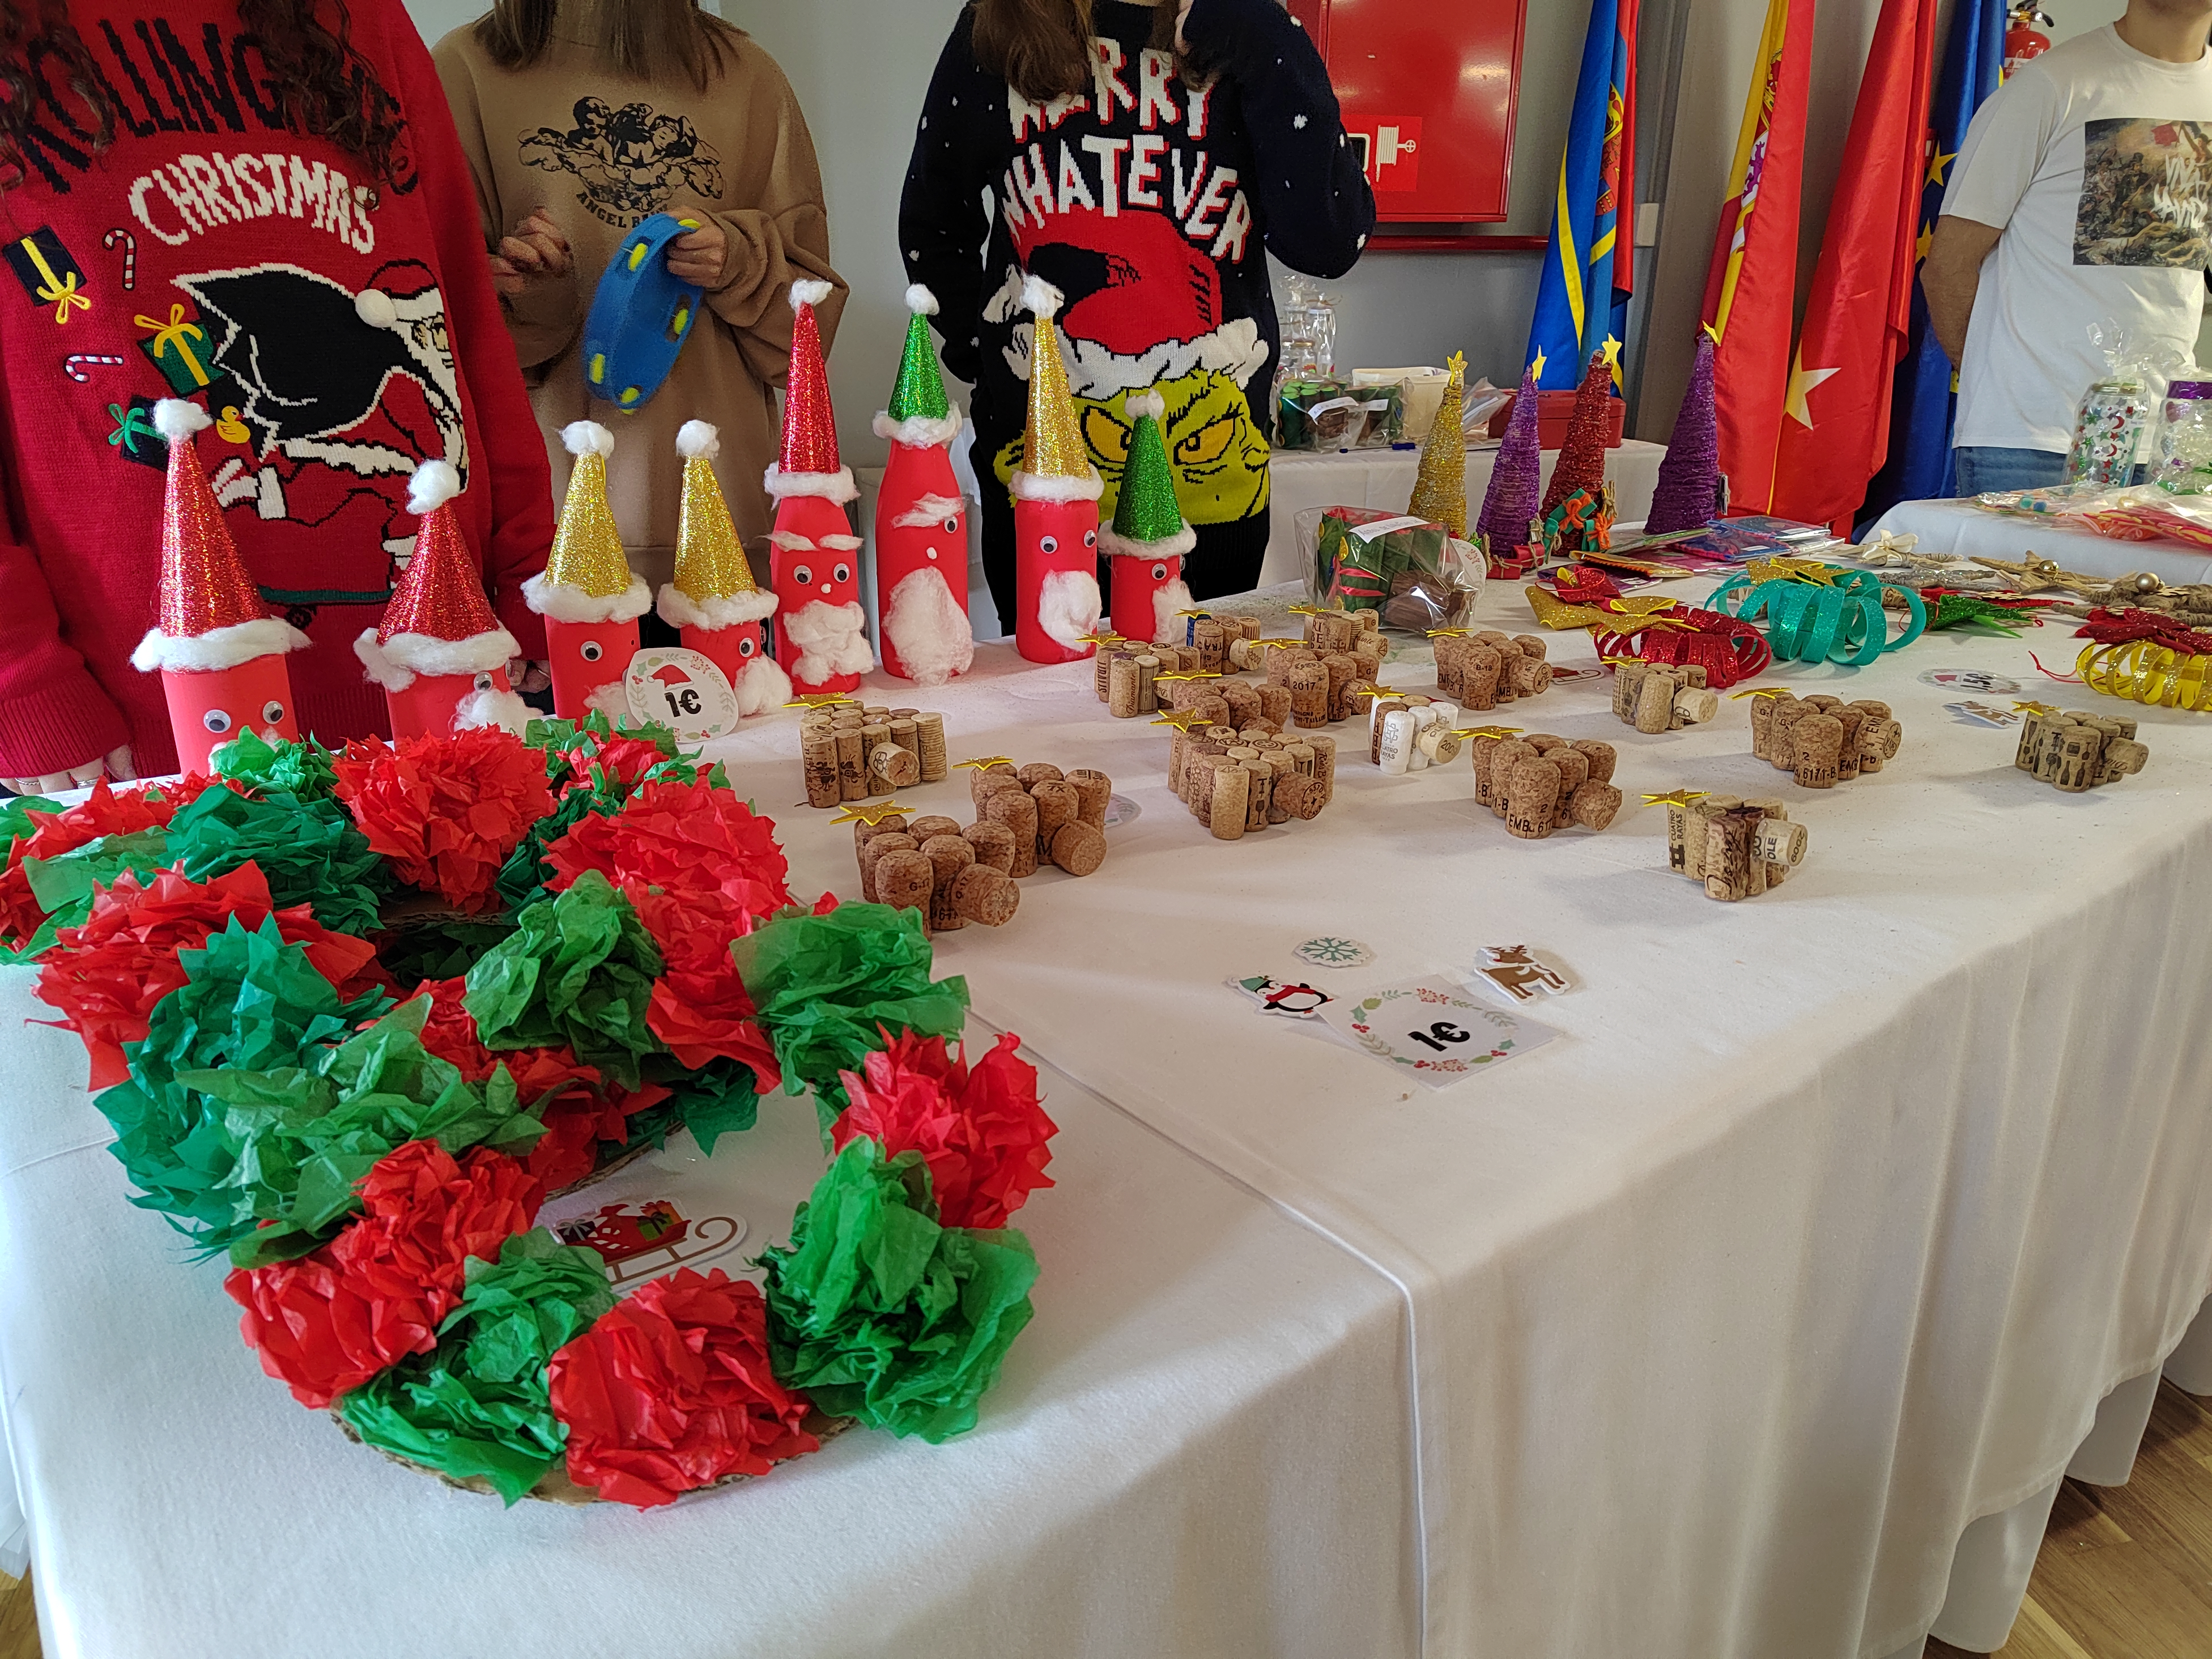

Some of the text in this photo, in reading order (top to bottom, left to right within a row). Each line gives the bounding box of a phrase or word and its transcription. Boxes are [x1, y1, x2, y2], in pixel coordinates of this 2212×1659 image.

[127, 152, 379, 254] CHRISTMAS
[576, 189, 627, 228] ANGEL
[1002, 134, 1251, 263] WHATEVER
[1126, 674, 1137, 714] Diamante
[1292, 680, 1316, 691] 2017
[664, 689, 702, 718] 1€
[1541, 803, 1549, 814] 2
[1767, 837, 1777, 860] OLE
[1790, 830, 1805, 863] 2009
[1407, 1022, 1470, 1052] 1€
